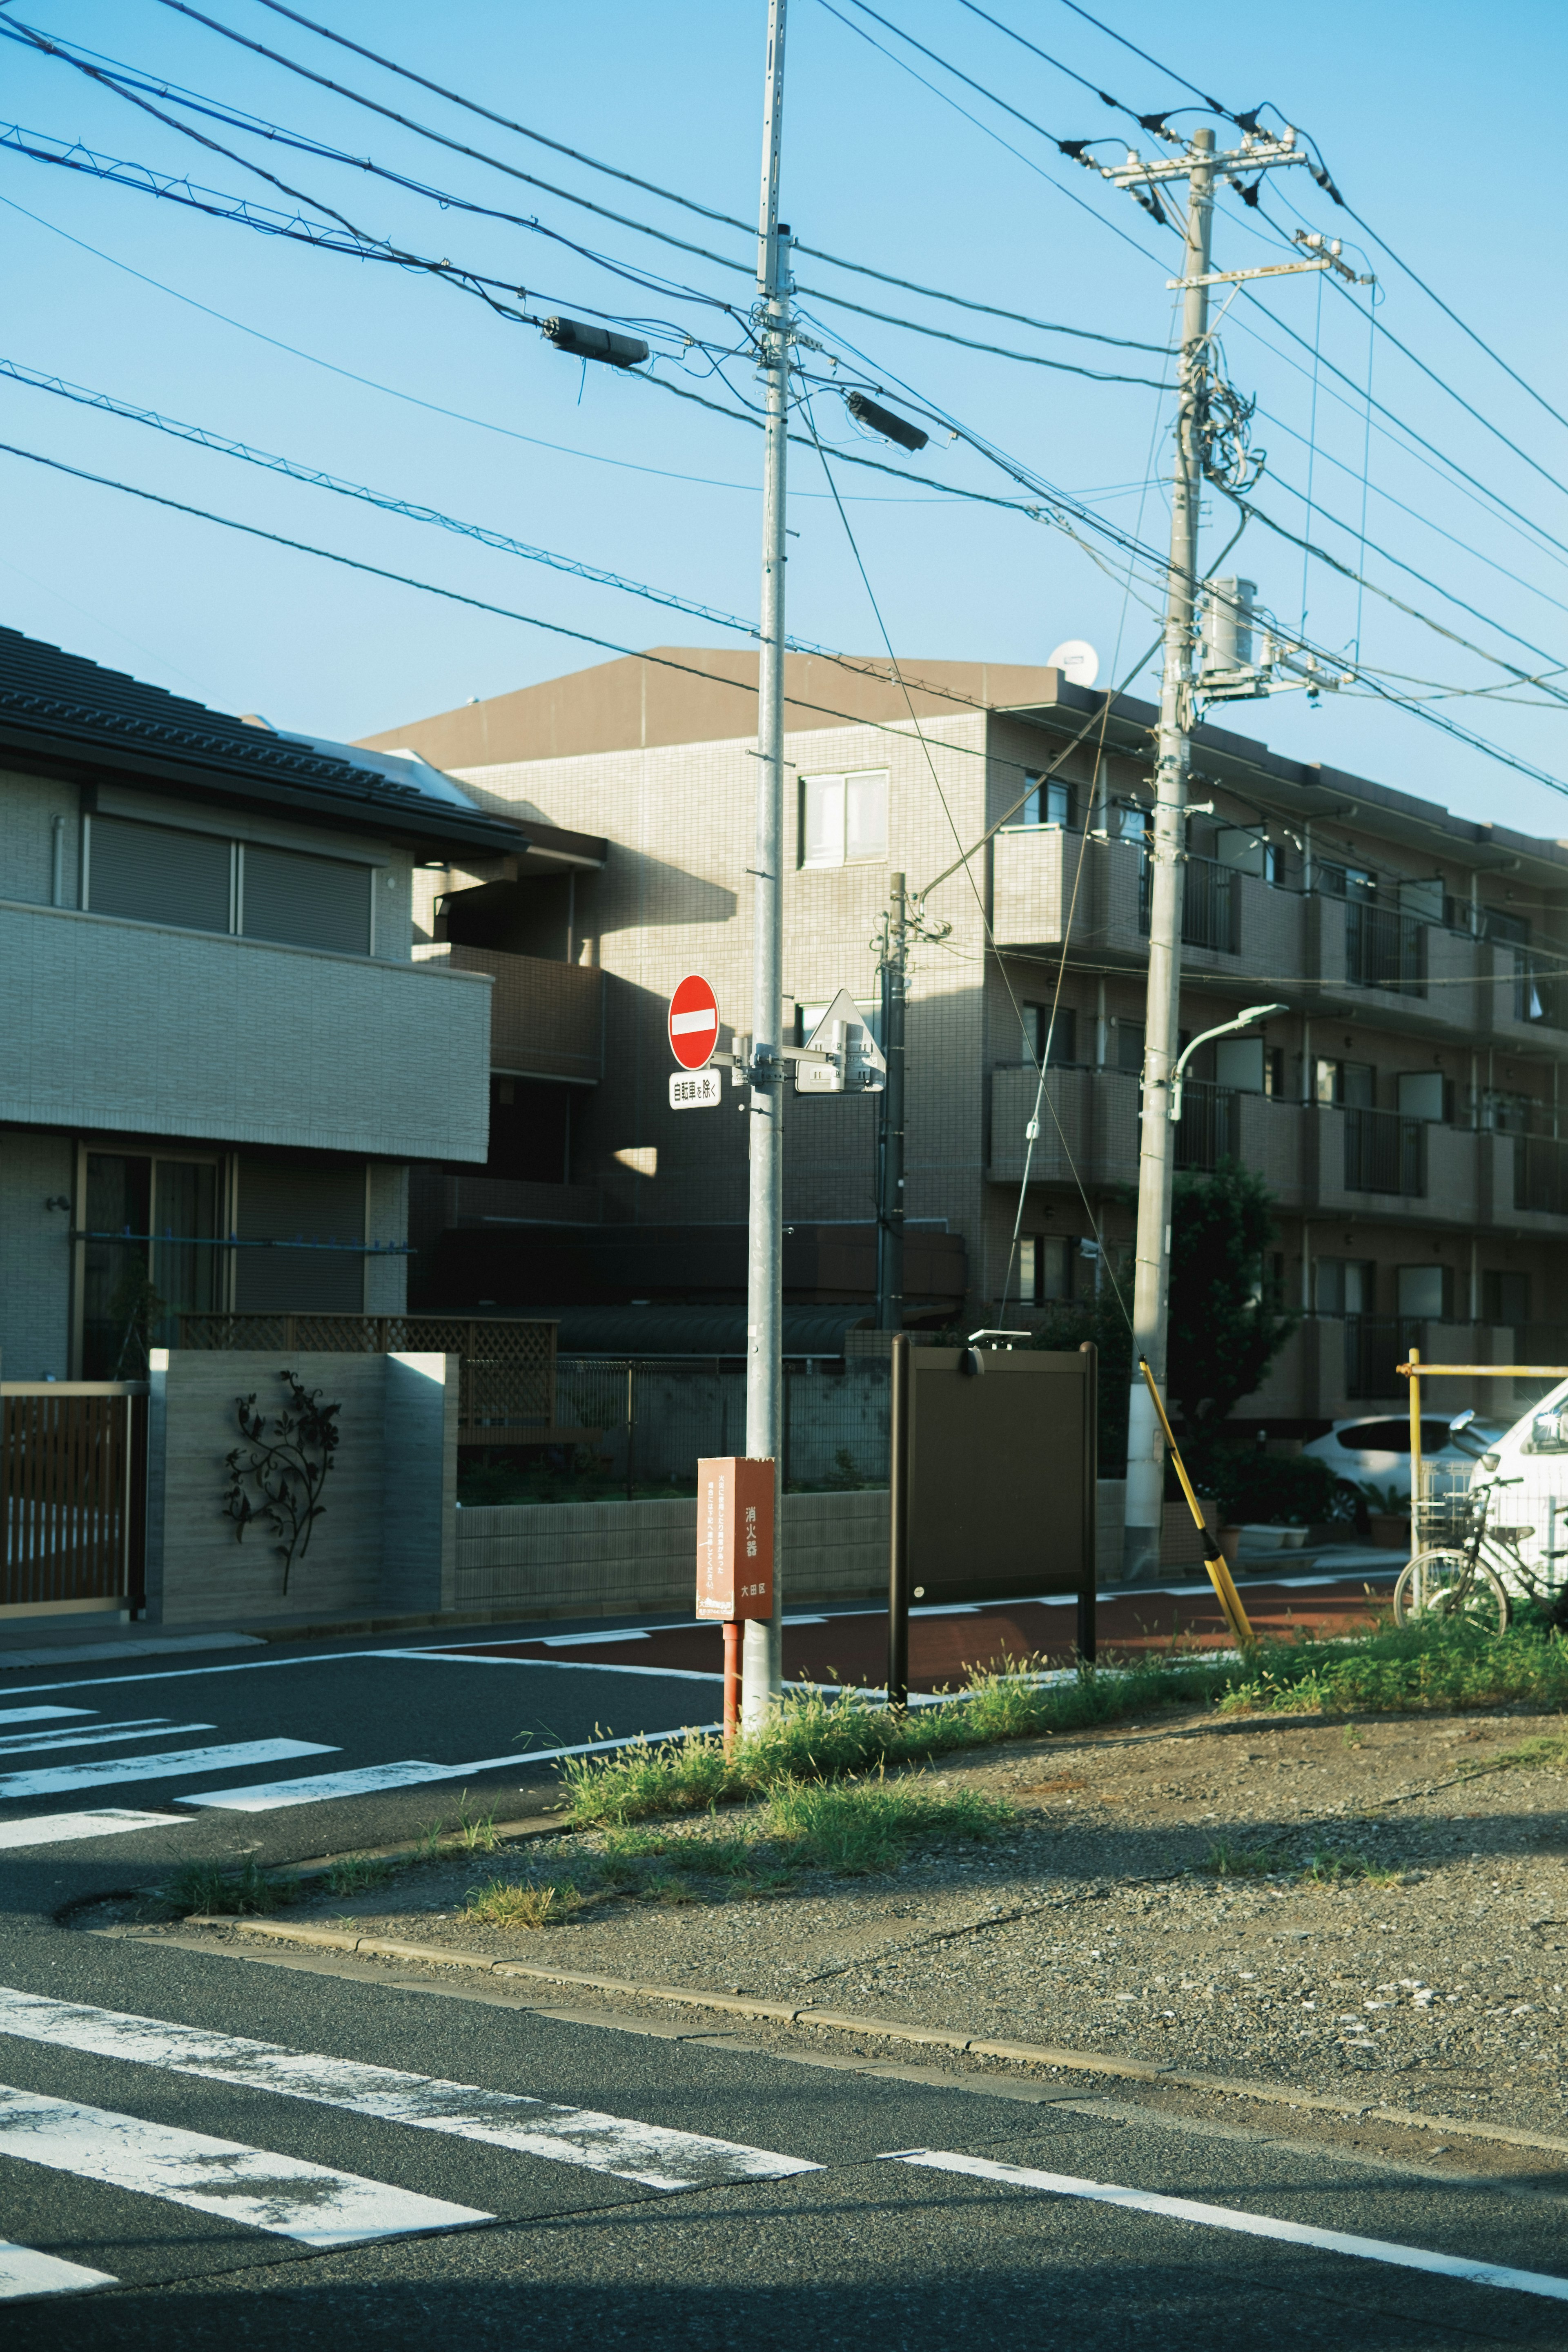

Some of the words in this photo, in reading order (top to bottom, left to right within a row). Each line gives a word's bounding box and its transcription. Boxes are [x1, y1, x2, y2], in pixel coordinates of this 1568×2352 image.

[675, 1079, 715, 1101] 自転車を除く
[746, 1506, 757, 1557] 消火器
[741, 1582, 766, 1597] 大田区
